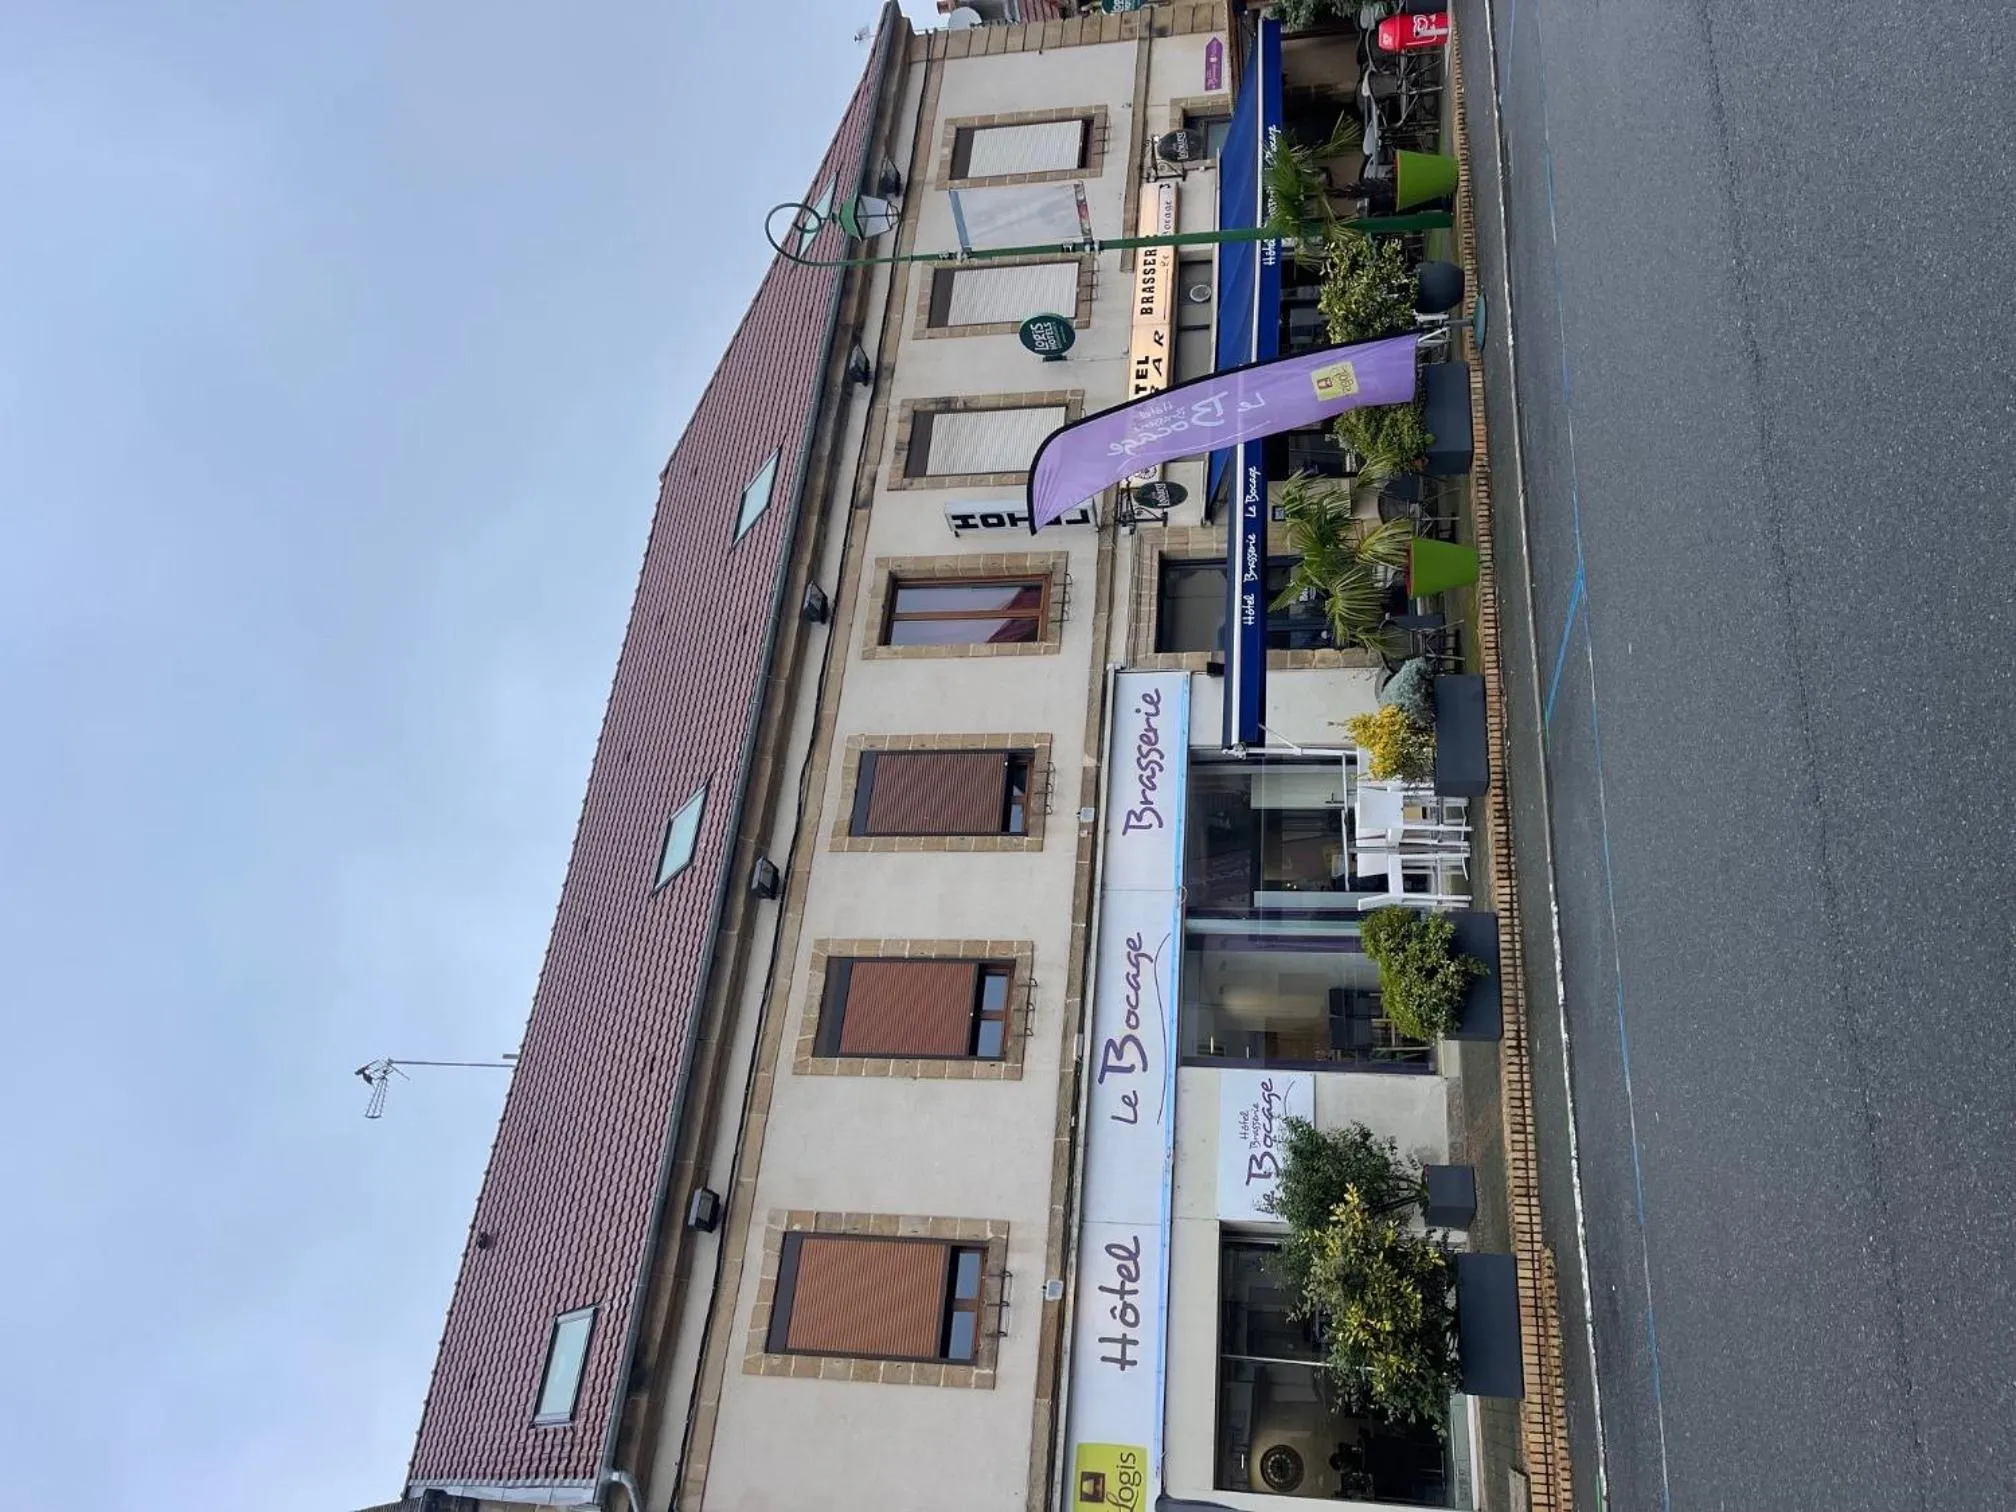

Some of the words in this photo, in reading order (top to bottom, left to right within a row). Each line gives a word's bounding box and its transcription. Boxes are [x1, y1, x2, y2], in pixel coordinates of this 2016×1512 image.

[1140, 235, 1158, 316] BRASSER
[1134, 355, 1149, 395] TEL
[1244, 466, 1260, 503] Bocage
[951, 509, 1090, 529] HOTL
[1245, 506, 1257, 518] Le
[1243, 533, 1258, 582] Brasserie
[1242, 593, 1256, 626] Hôtel
[1122, 687, 1165, 836] Brasserie
[1097, 932, 1154, 1085] Bocage
[1110, 1090, 1139, 1125] Le
[1245, 1077, 1281, 1186] Bocage
[1098, 1235, 1141, 1371] Hôtel
